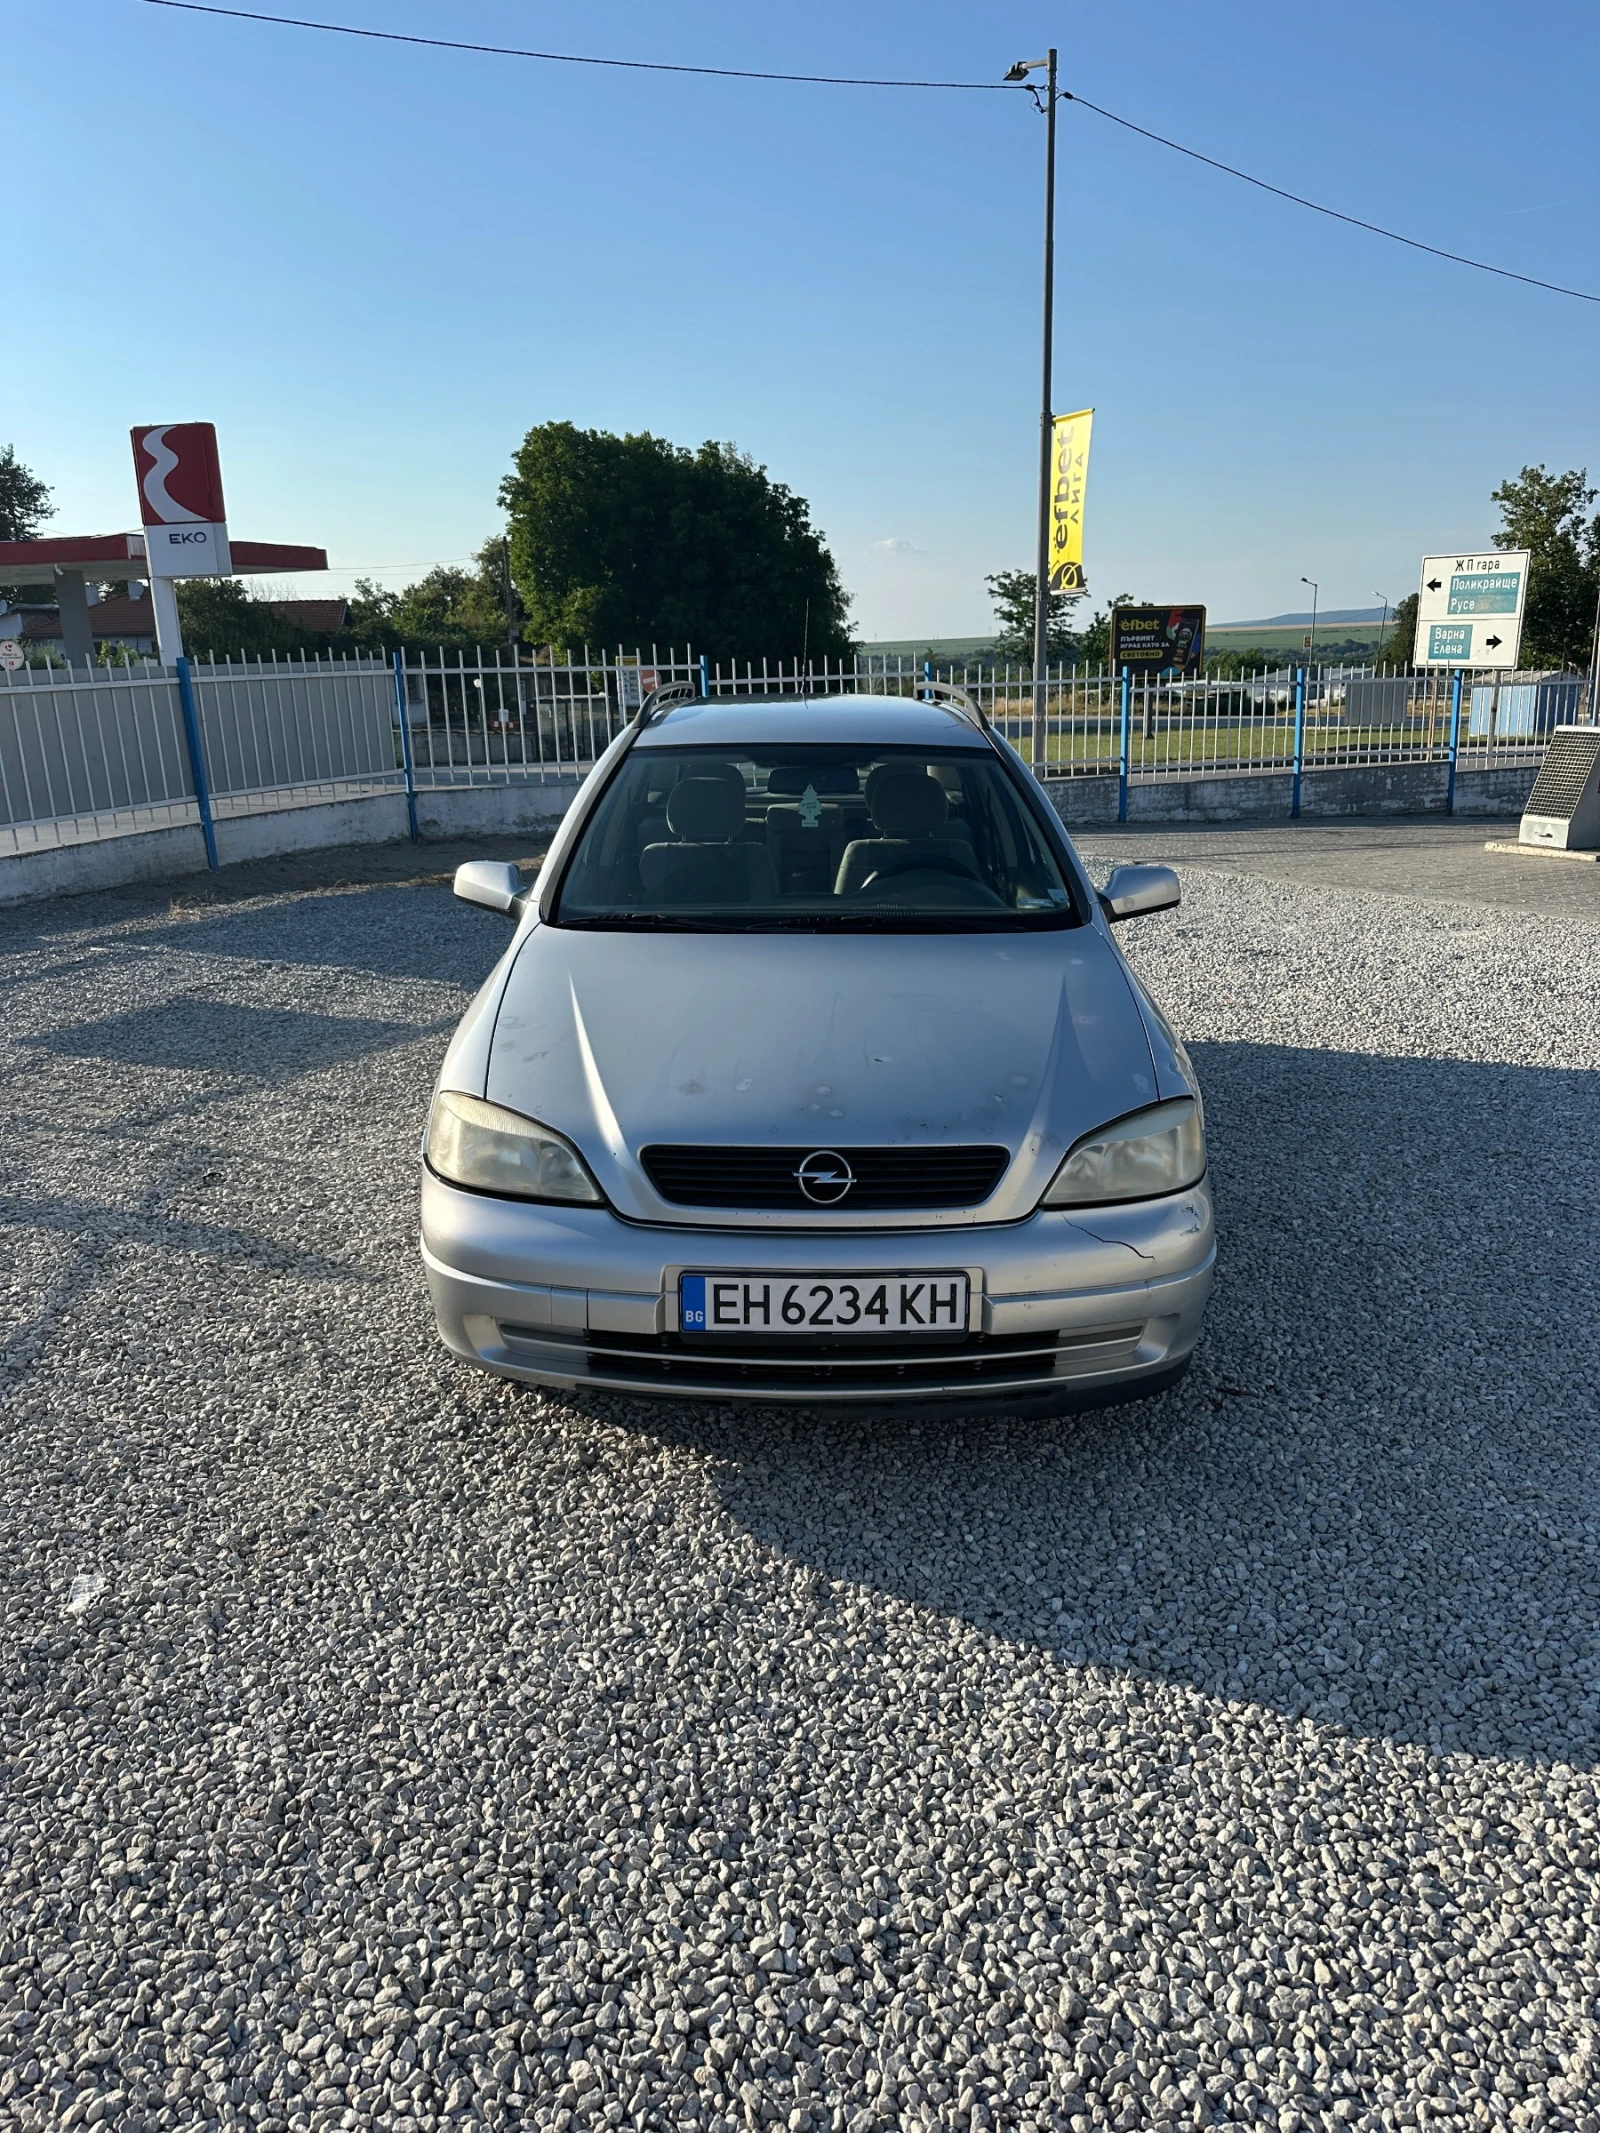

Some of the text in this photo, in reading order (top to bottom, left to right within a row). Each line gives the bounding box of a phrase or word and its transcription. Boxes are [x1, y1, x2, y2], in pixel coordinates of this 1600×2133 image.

[1070, 452, 1084, 525] ЛИГА
[169, 531, 207, 544] EKO
[1476, 560, 1500, 573] гара
[1452, 577, 1517, 593] Поликрайще
[1450, 598, 1475, 613] Русе
[1435, 627, 1465, 643] Варна
[1433, 641, 1463, 655] Елена
[781, 1284, 889, 1325] 6234
[685, 1310, 704, 1323] BG
